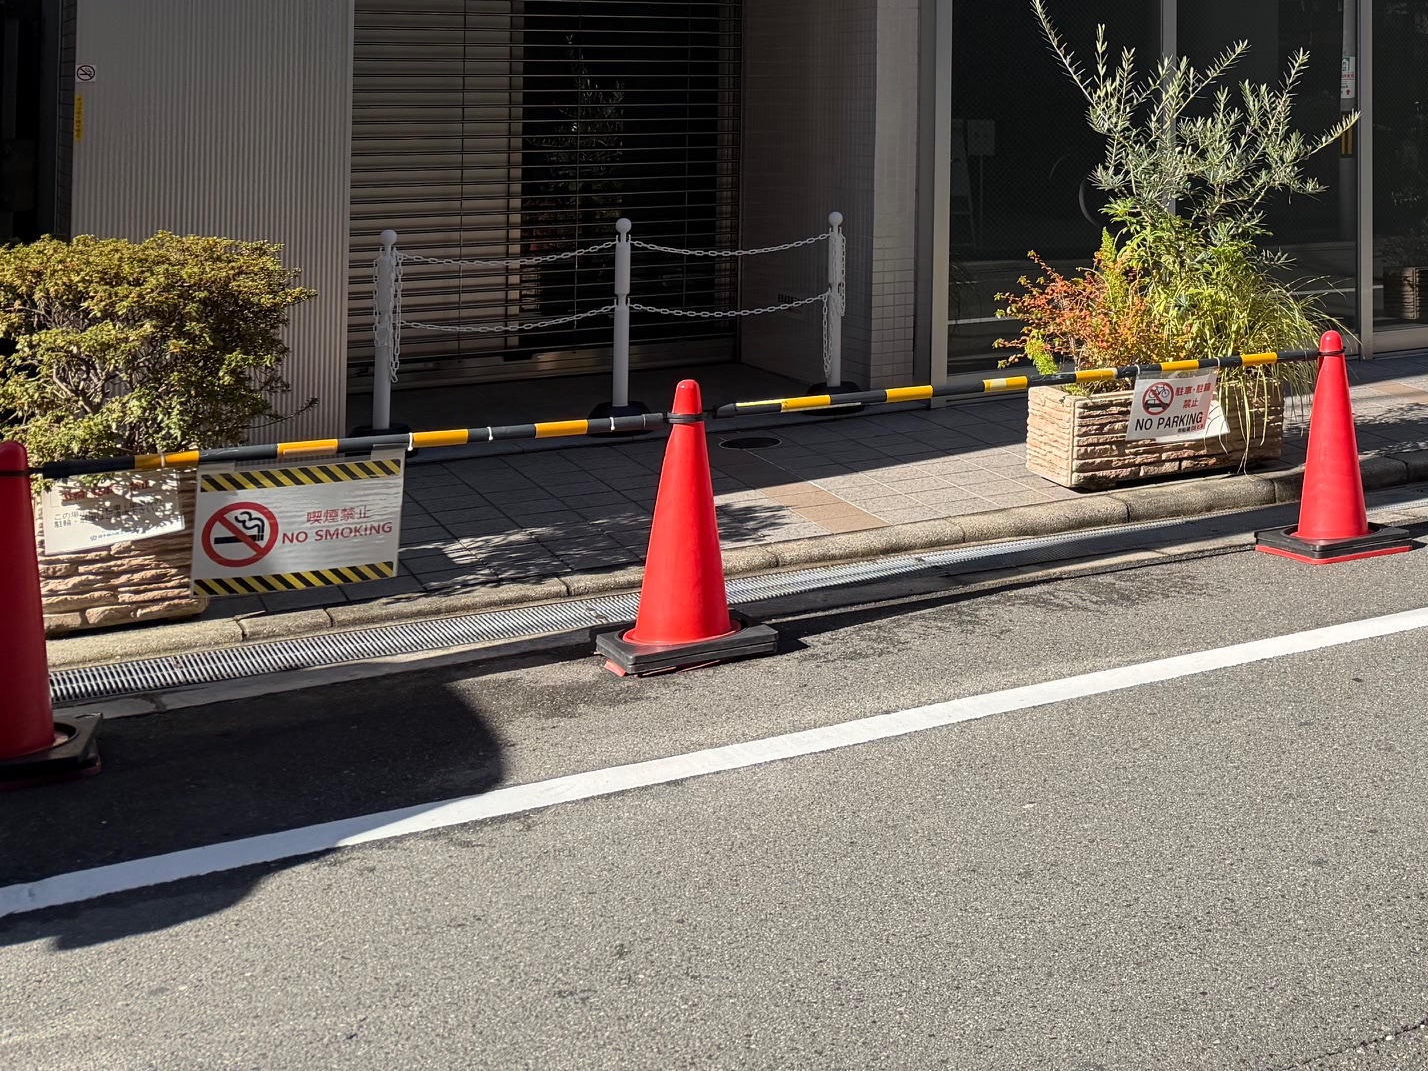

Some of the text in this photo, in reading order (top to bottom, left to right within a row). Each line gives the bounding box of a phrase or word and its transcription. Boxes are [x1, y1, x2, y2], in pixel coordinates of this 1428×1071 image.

[1182, 397, 1199, 409] 禁止
[1134, 411, 1204, 431] NO PARKING
[306, 505, 373, 525] 喫煙禁止
[282, 521, 393, 544] NO SMOKING
